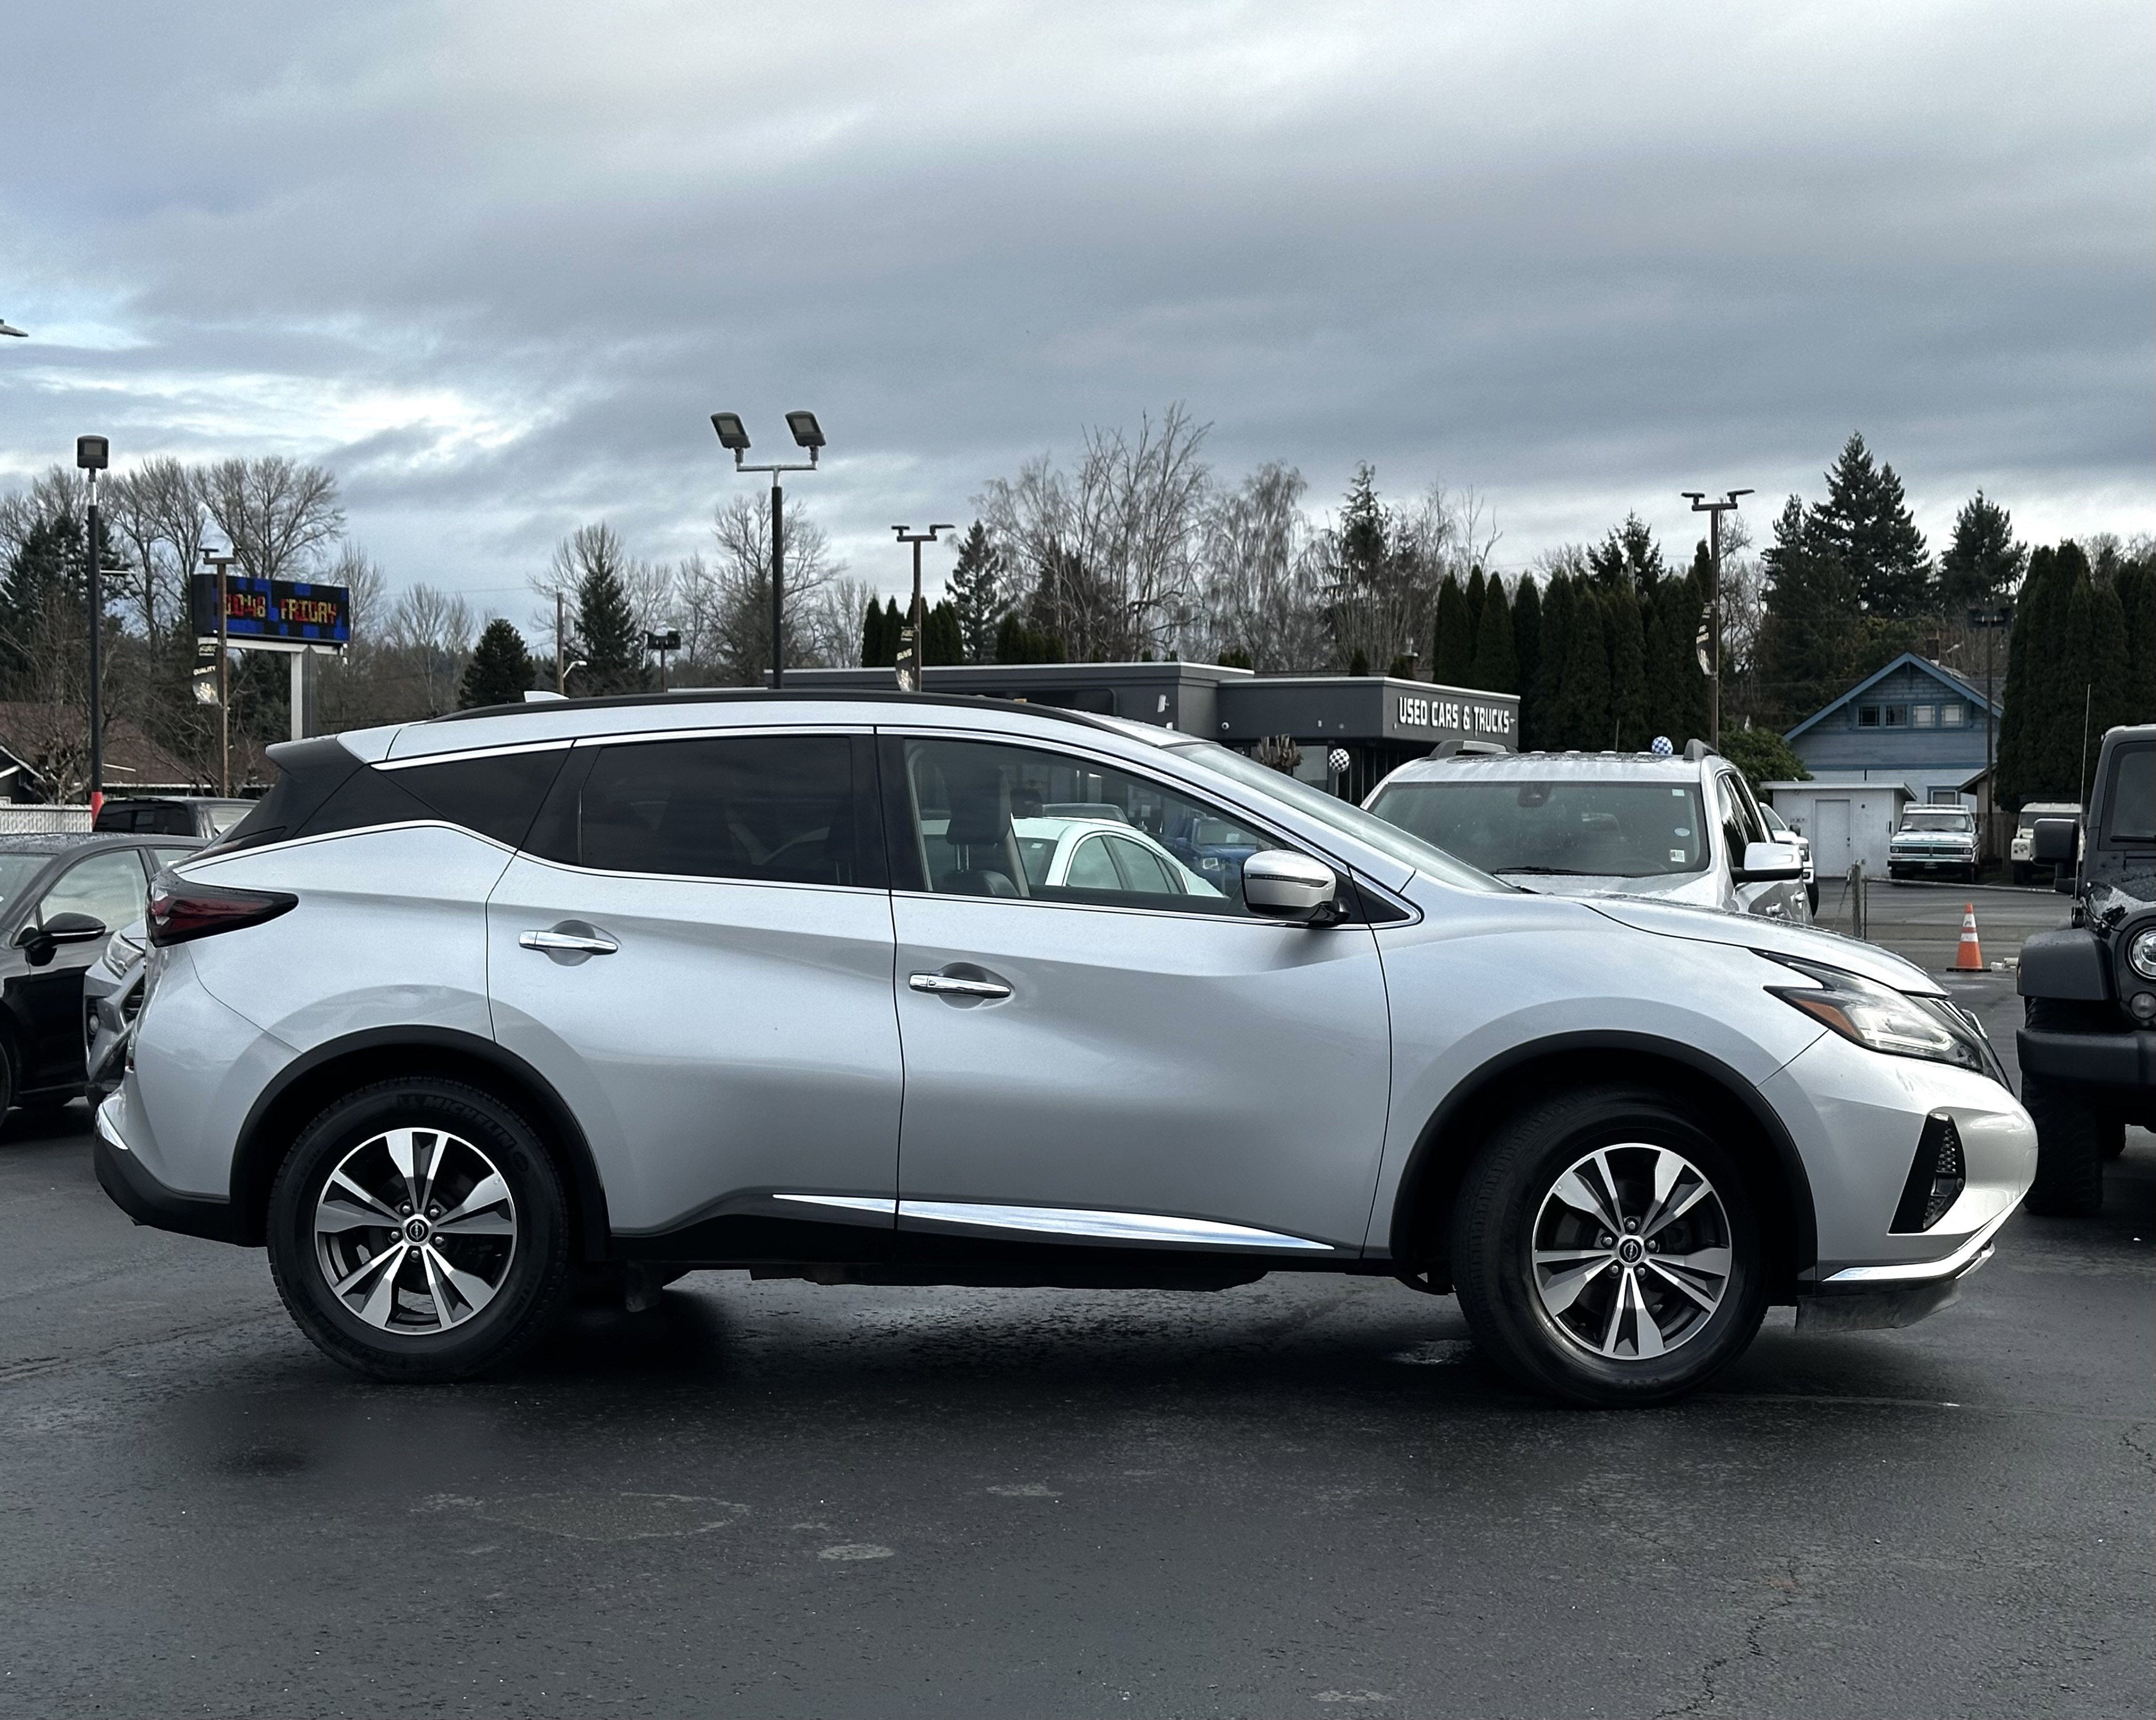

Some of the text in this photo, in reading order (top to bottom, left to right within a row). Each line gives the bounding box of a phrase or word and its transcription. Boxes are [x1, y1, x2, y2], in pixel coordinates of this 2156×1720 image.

[280, 598, 337, 624] FRIDAY
[193, 665, 216, 676] QUALITY
[1399, 696, 1509, 733] USED CARS & TRUCKS
[423, 1094, 518, 1150] MICHELIN
